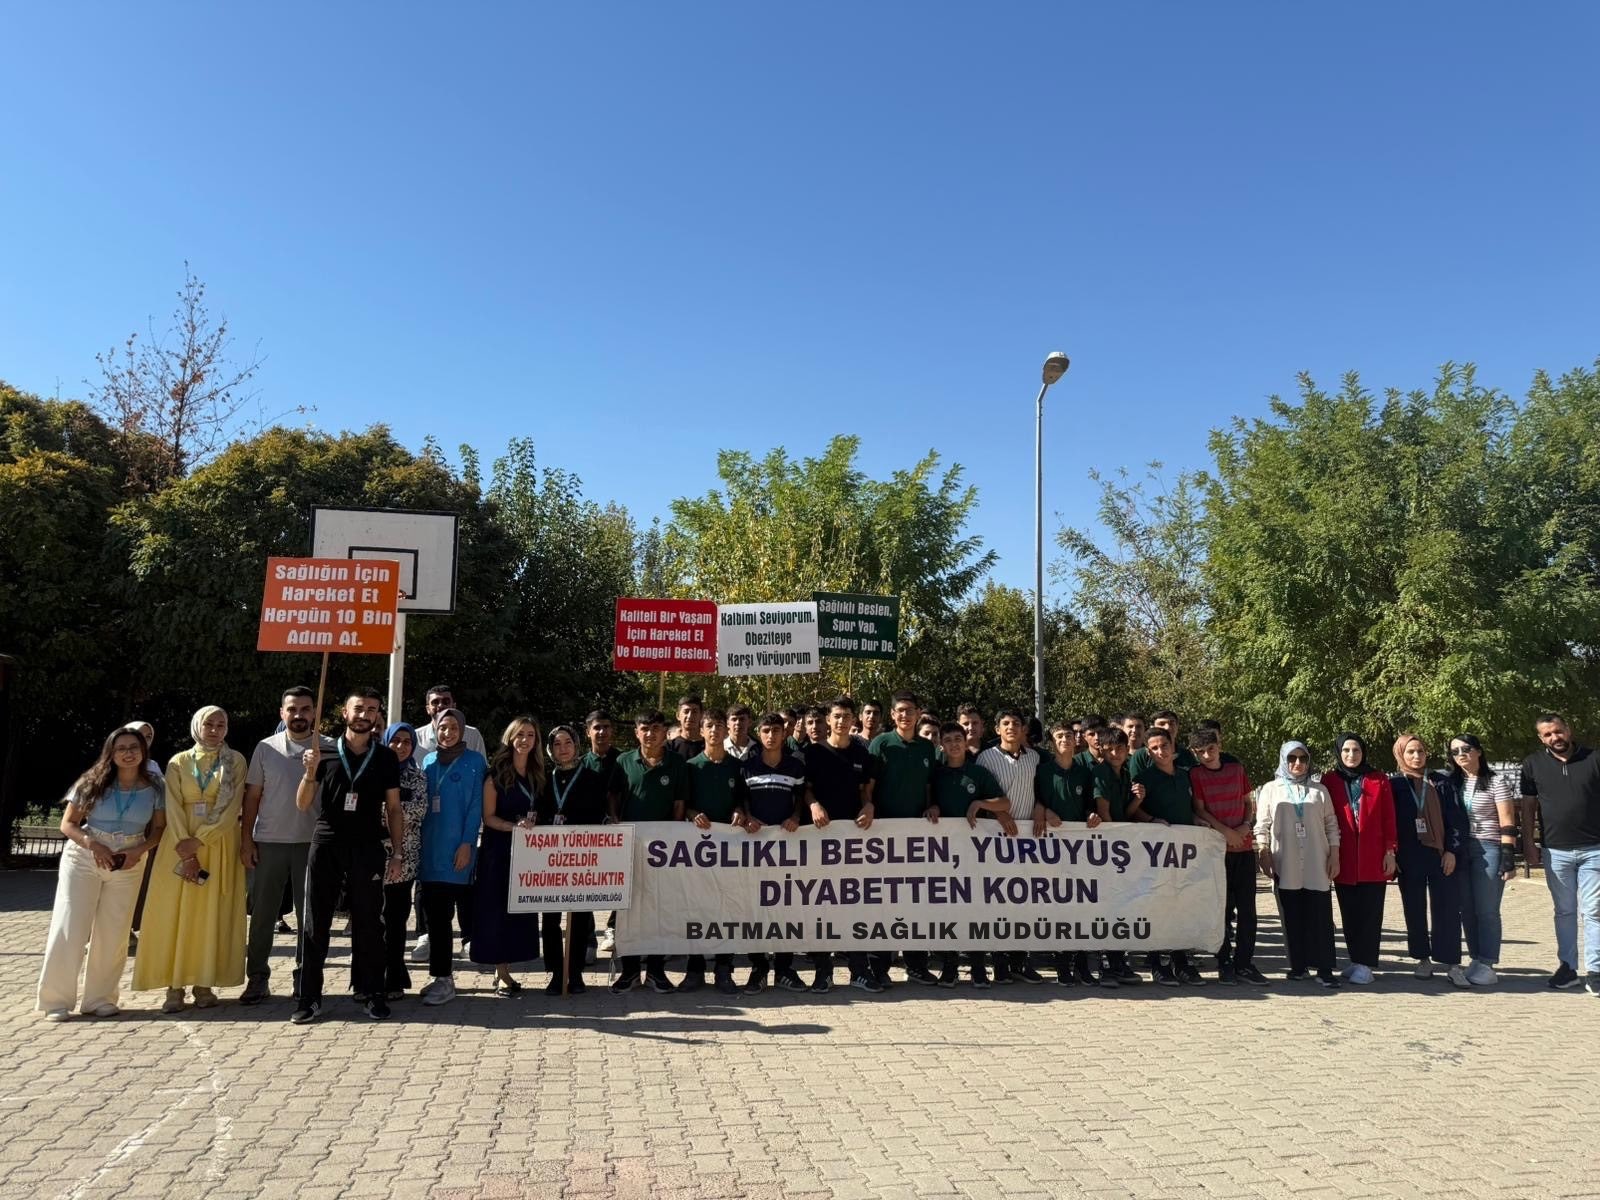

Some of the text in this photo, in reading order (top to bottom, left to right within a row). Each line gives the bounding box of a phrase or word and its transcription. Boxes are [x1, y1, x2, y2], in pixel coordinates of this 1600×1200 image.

[275, 564, 390, 584] Sağlığın İçin
[282, 586, 379, 603] Hareket Et
[819, 600, 855, 614] Sağlıklı
[265, 608, 392, 625] Hergün 10 Bin
[620, 610, 712, 626] Kaliteli Bir Yaşam
[721, 611, 815, 626] Kalbimi Seviyorum.
[627, 626, 704, 642] İçin Hareket Et
[833, 619, 856, 632] Spor
[287, 629, 363, 646] Adım At.
[745, 631, 792, 646] Obeziteye
[819, 636, 896, 653] beziteye Dur De.
[617, 645, 712, 660] Ve Dengeli Beslen.
[728, 650, 811, 669] Karşı Yürüyorum
[525, 831, 623, 851] YAŞAM YÜRÜMEKLE
[548, 851, 598, 867] GÜZELDİR
[647, 832, 1197, 873] SAĞLIKLI BESLEN, YÜRÜYÜŞ YAP
[519, 870, 625, 887] YÜRÜMEK SAĞLIKTIR
[518, 893, 622, 904] BATMAN HALK SAĞLIĞI MÜDÜRLÜĞÜ
[760, 873, 1099, 907] DİYABETTEN KORUN
[686, 918, 1151, 940] BATMAN İL SAĞLIK MÜDÜRLÜĞÜ
